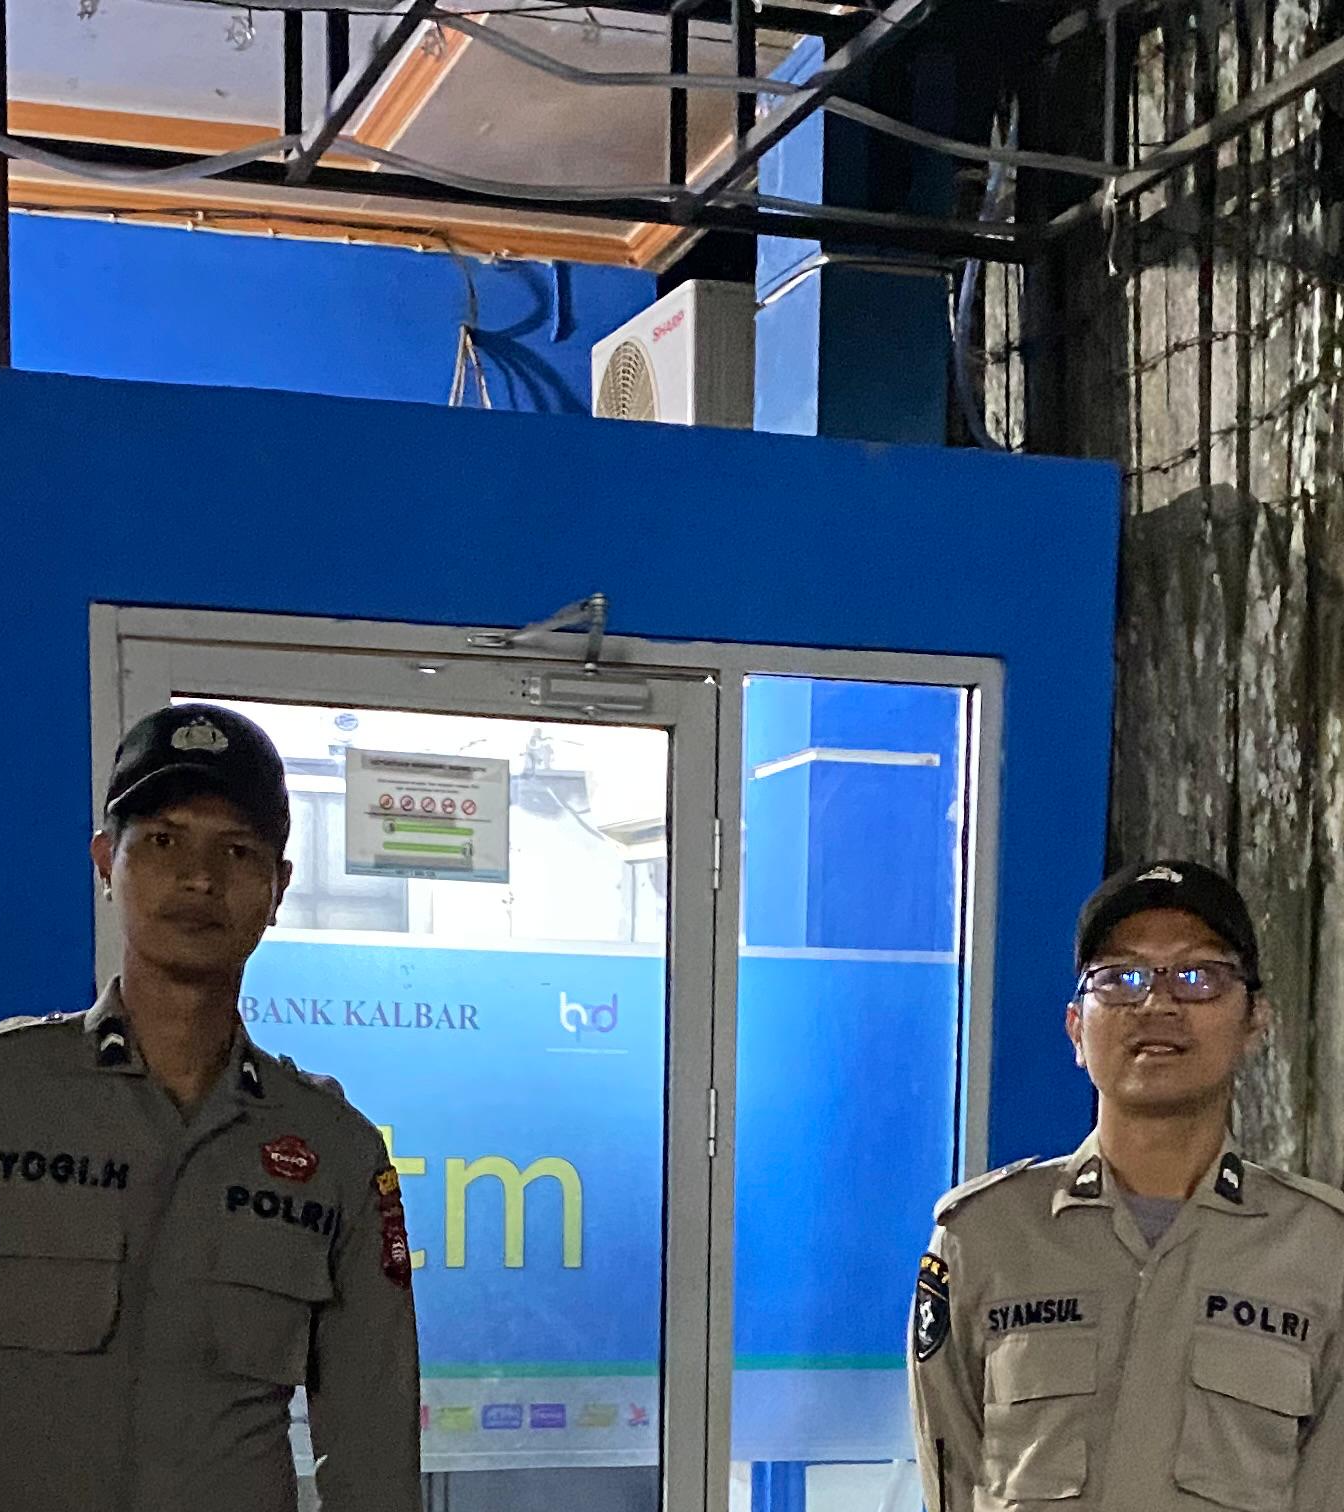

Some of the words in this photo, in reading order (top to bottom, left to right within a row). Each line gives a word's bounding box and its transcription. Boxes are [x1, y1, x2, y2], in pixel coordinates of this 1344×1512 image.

[240, 996, 336, 1026] BANK
[343, 1000, 481, 1030] KALBAR
[226, 1185, 335, 1236] POLRI
[987, 1298, 1083, 1332] SYAMSUL
[1206, 1295, 1310, 1341] POLRI
